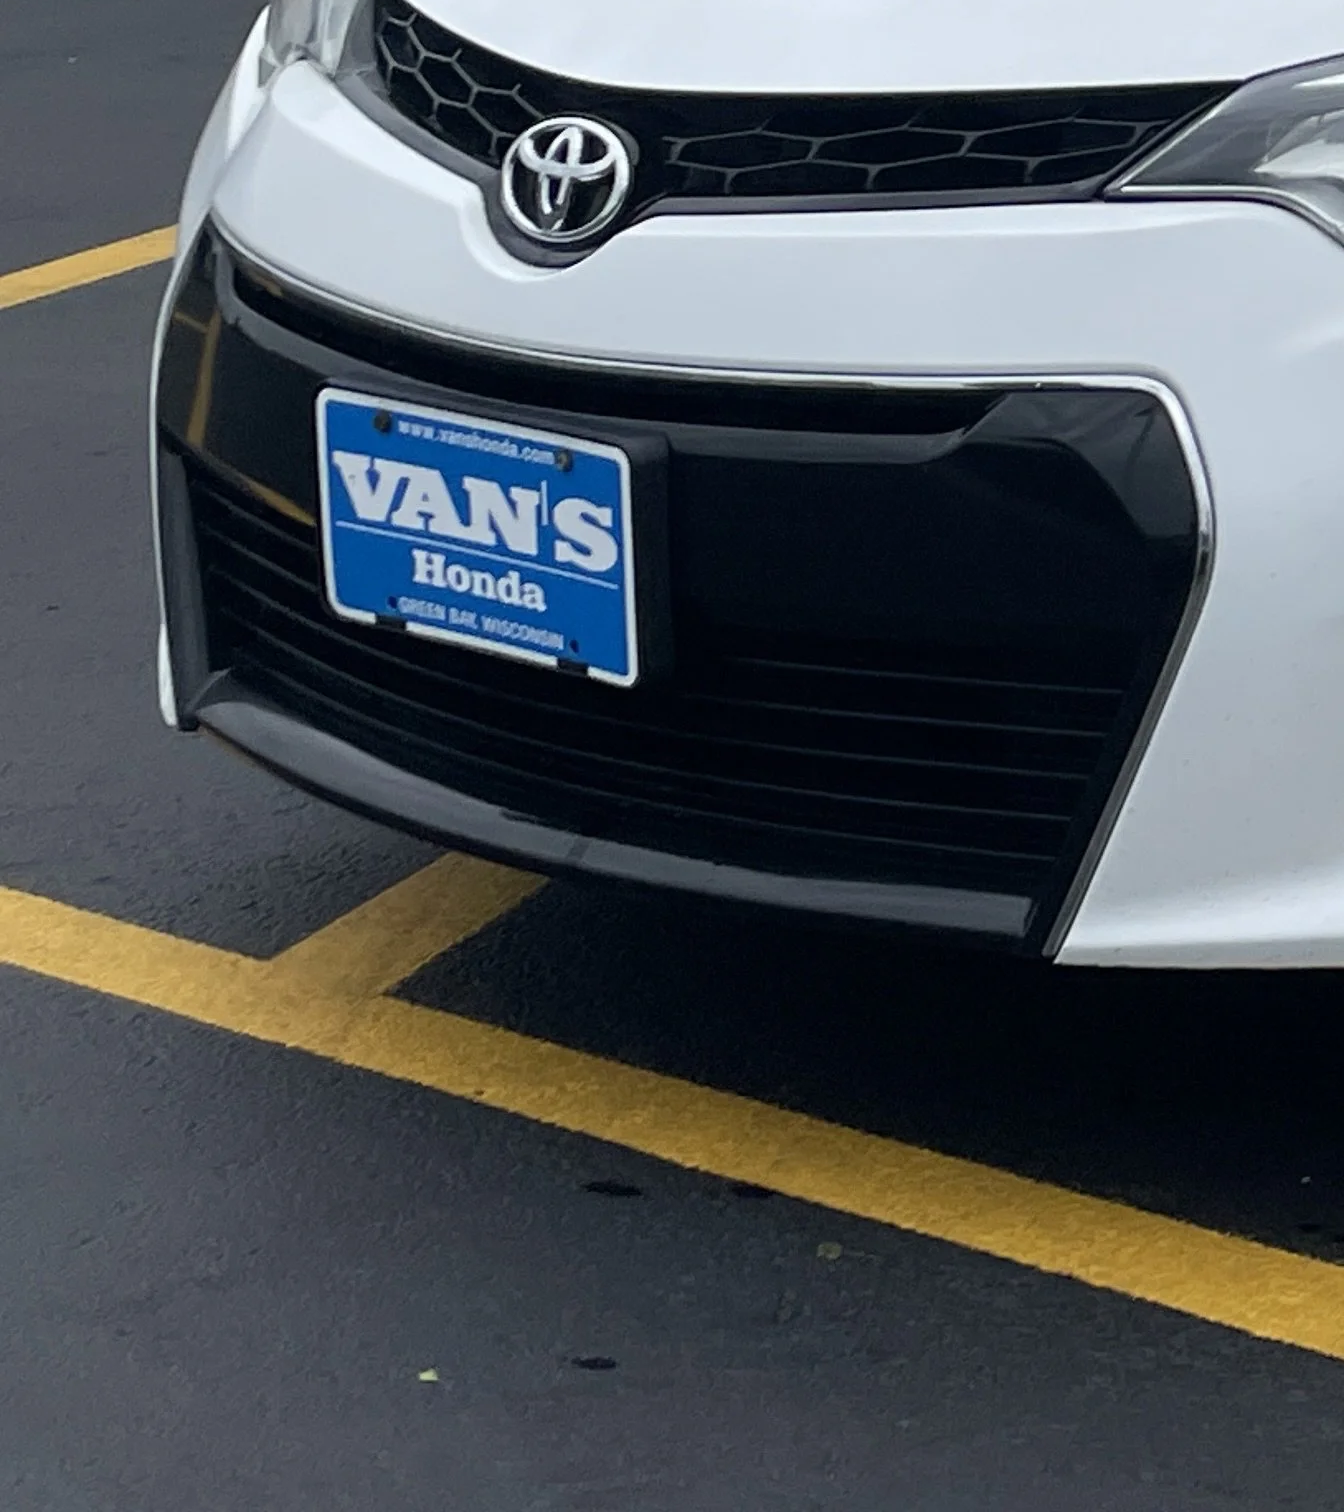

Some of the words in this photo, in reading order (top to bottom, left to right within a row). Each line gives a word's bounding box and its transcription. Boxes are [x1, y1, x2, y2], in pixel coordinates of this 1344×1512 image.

[398, 420, 556, 466] www.vanshonda.com
[332, 449, 619, 573] VAN'S
[412, 548, 547, 612] Honda
[399, 595, 447, 621] GREEN
[481, 615, 564, 651] WISCONSIN
